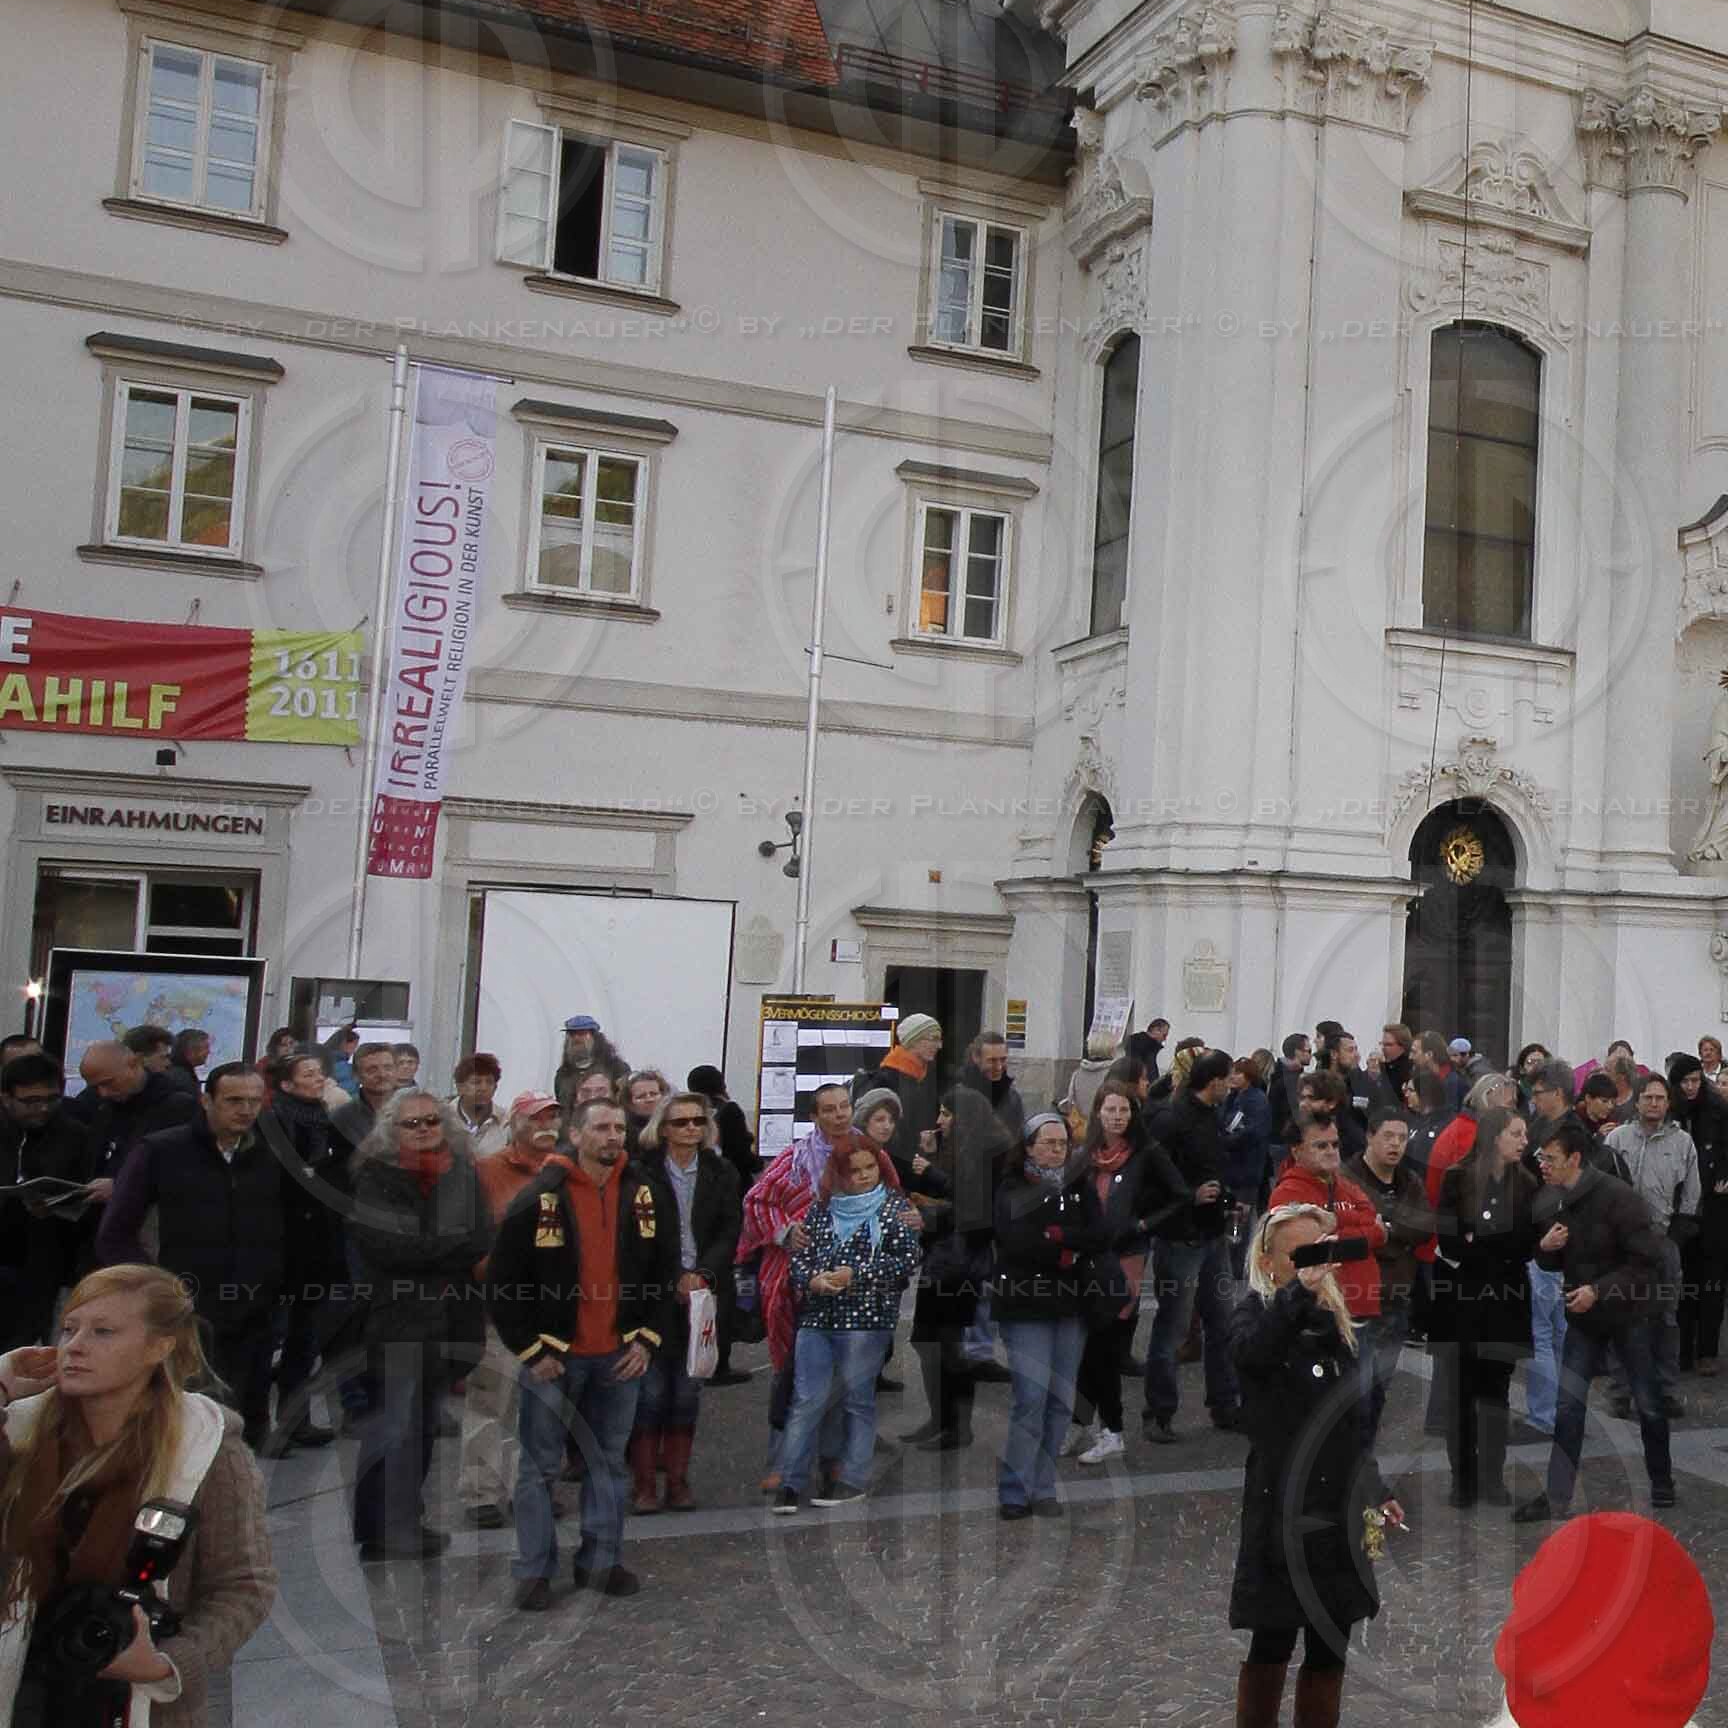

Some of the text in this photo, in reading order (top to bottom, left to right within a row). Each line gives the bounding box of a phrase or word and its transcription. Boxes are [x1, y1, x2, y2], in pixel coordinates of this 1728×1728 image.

[465, 488, 485, 539] KUNST
[461, 543, 479, 572] DER
[458, 578, 474, 594] IN
[388, 481, 461, 789] IRREALIGIOUS!
[448, 600, 470, 672] RELIGION
[271, 686, 359, 721] 2011
[46, 804, 264, 835] EINRAHMUNGEN
